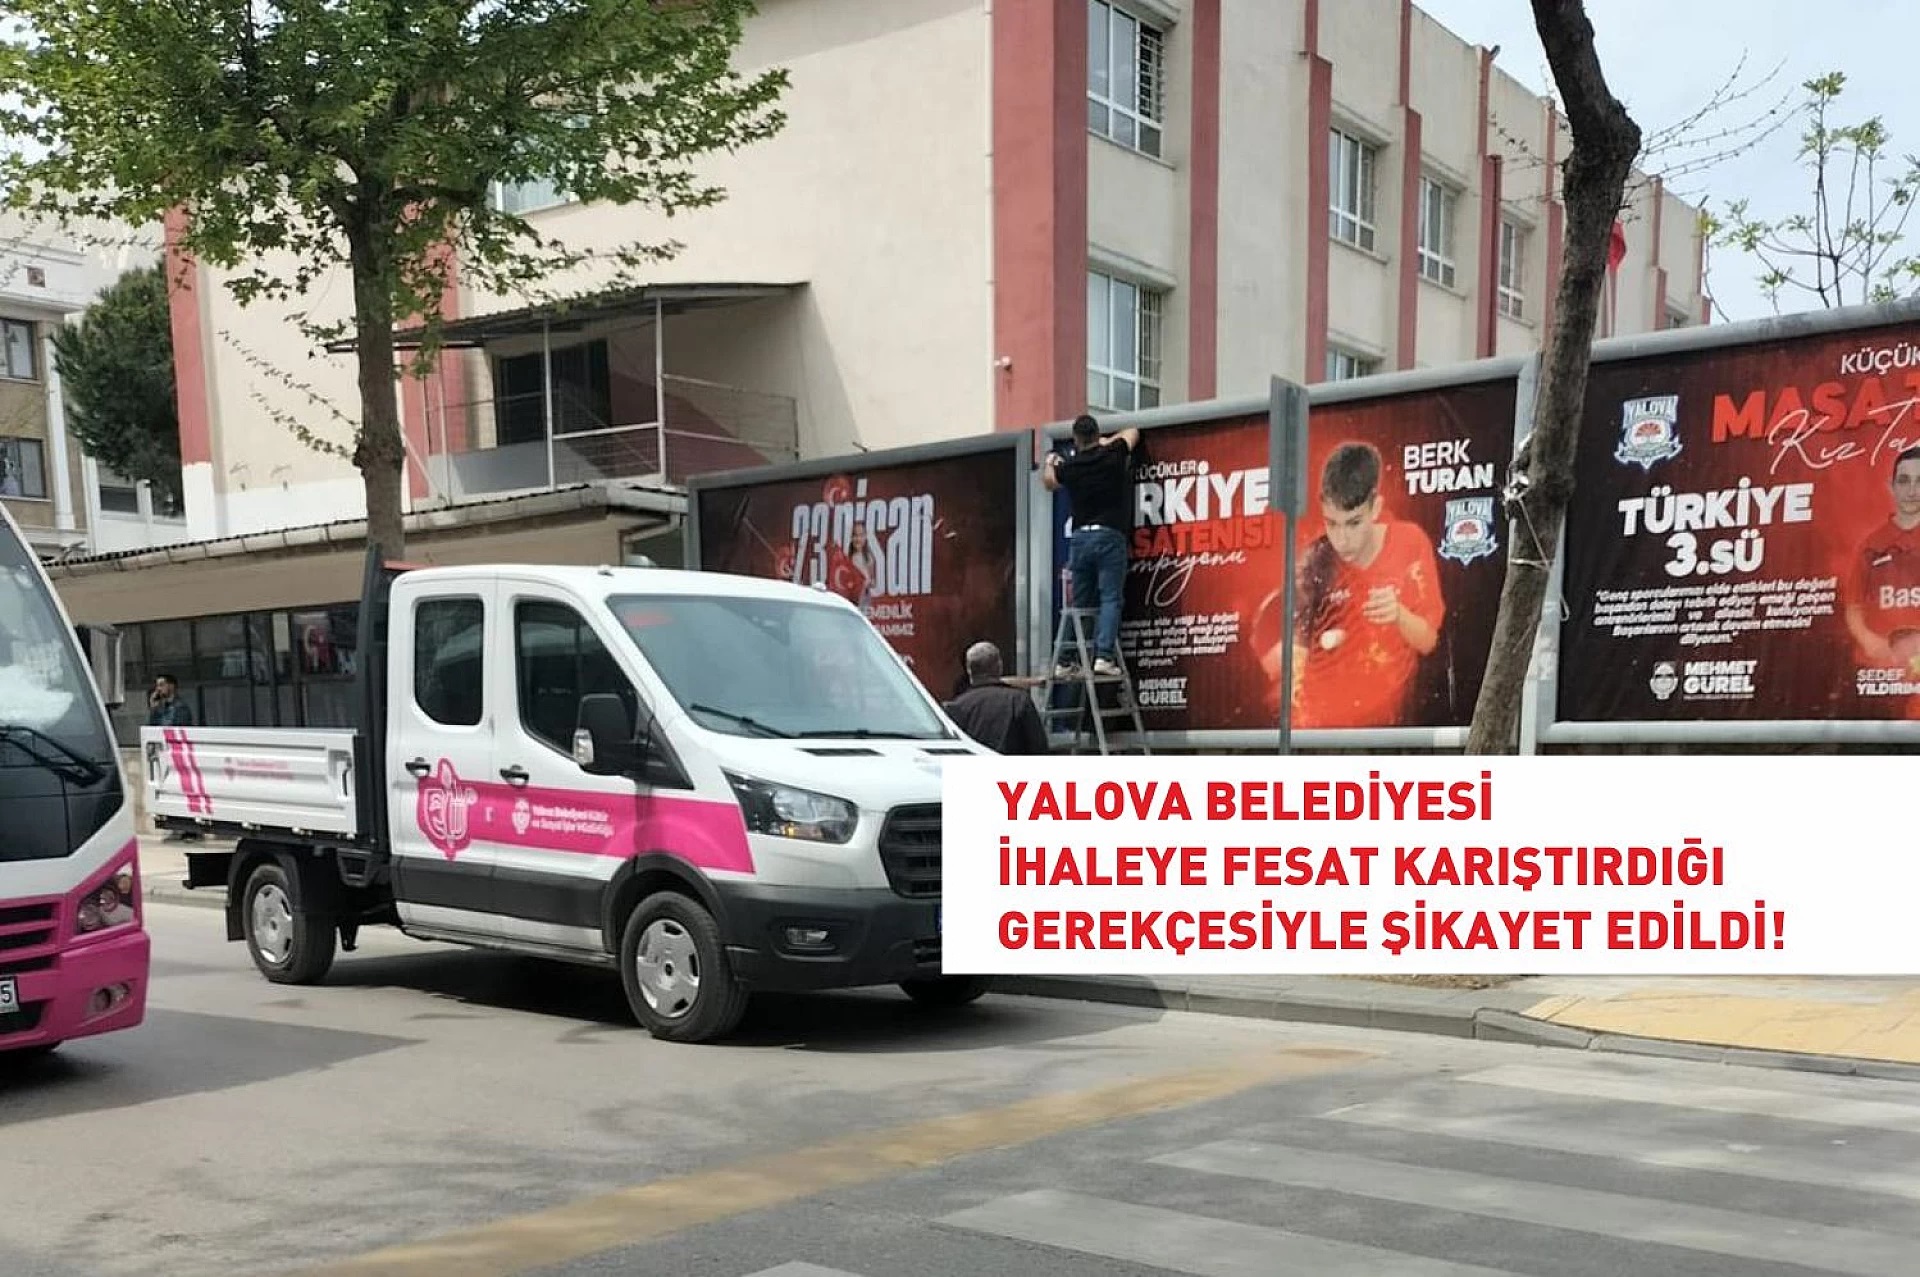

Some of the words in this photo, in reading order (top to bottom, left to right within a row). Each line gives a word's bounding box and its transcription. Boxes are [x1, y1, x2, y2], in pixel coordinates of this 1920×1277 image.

[1404, 438, 1471, 469] BERK
[1135, 460, 1270, 527] RKİYE
[1405, 463, 1494, 495] TURAN
[1618, 476, 1815, 536] TÜRKİYE
[1684, 660, 1758, 675] MEHMET
